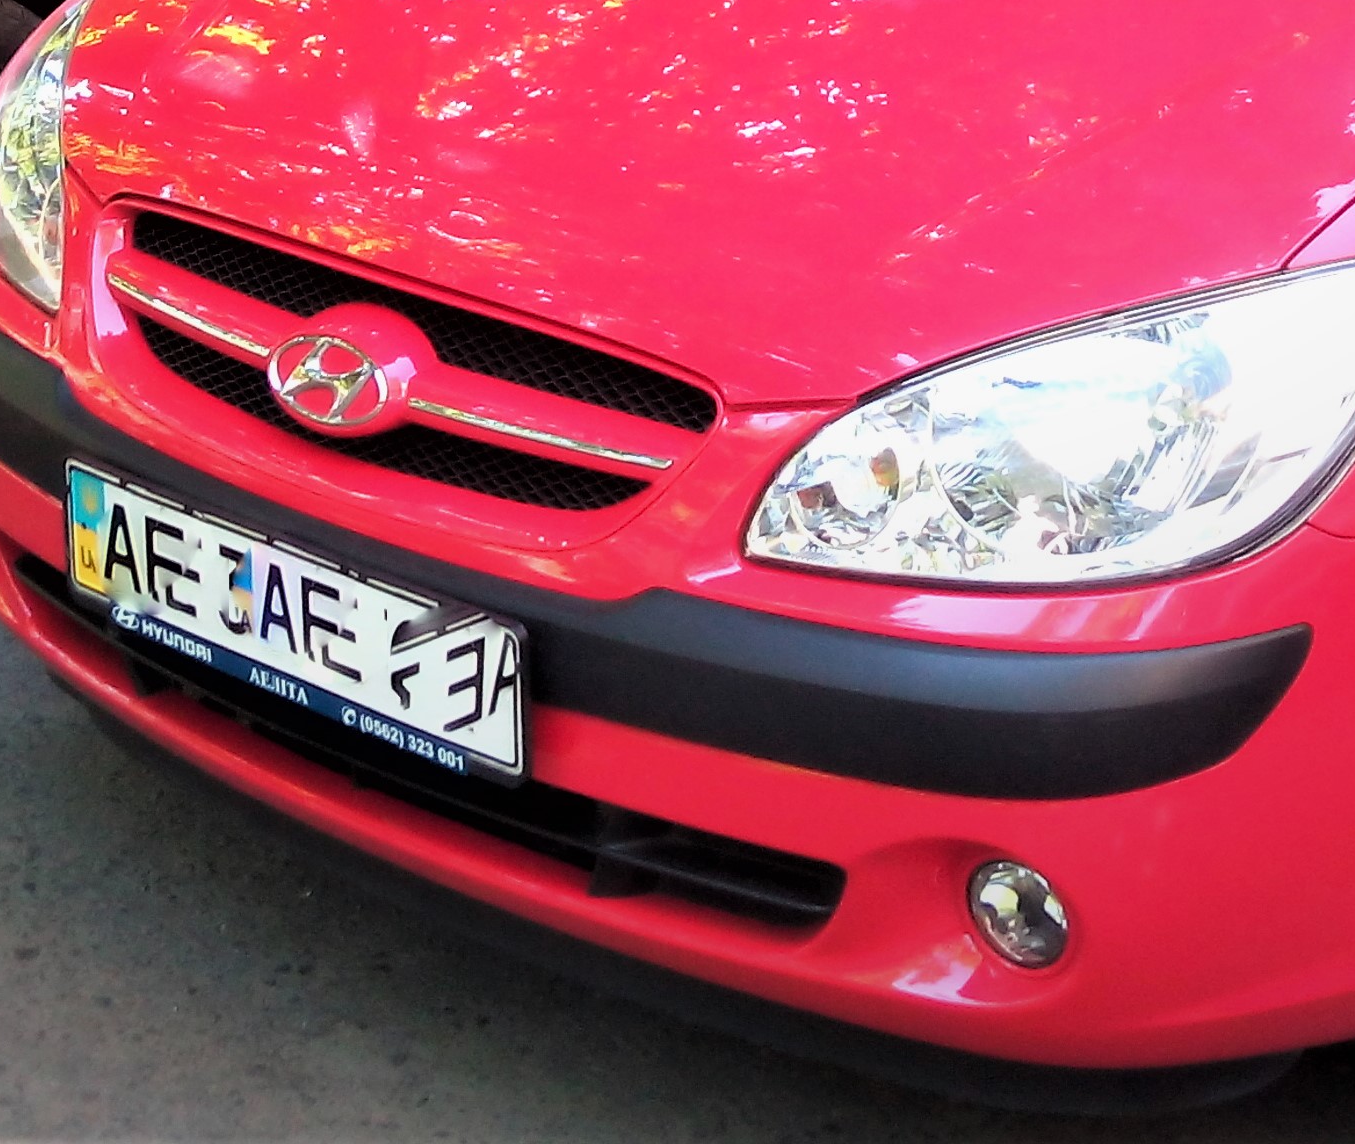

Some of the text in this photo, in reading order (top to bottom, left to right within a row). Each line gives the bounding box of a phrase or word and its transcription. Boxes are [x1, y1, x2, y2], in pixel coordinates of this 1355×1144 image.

[141, 619, 212, 663] HYUNDAI
[407, 734, 435, 759] 323
[437, 747, 464, 772] 001
